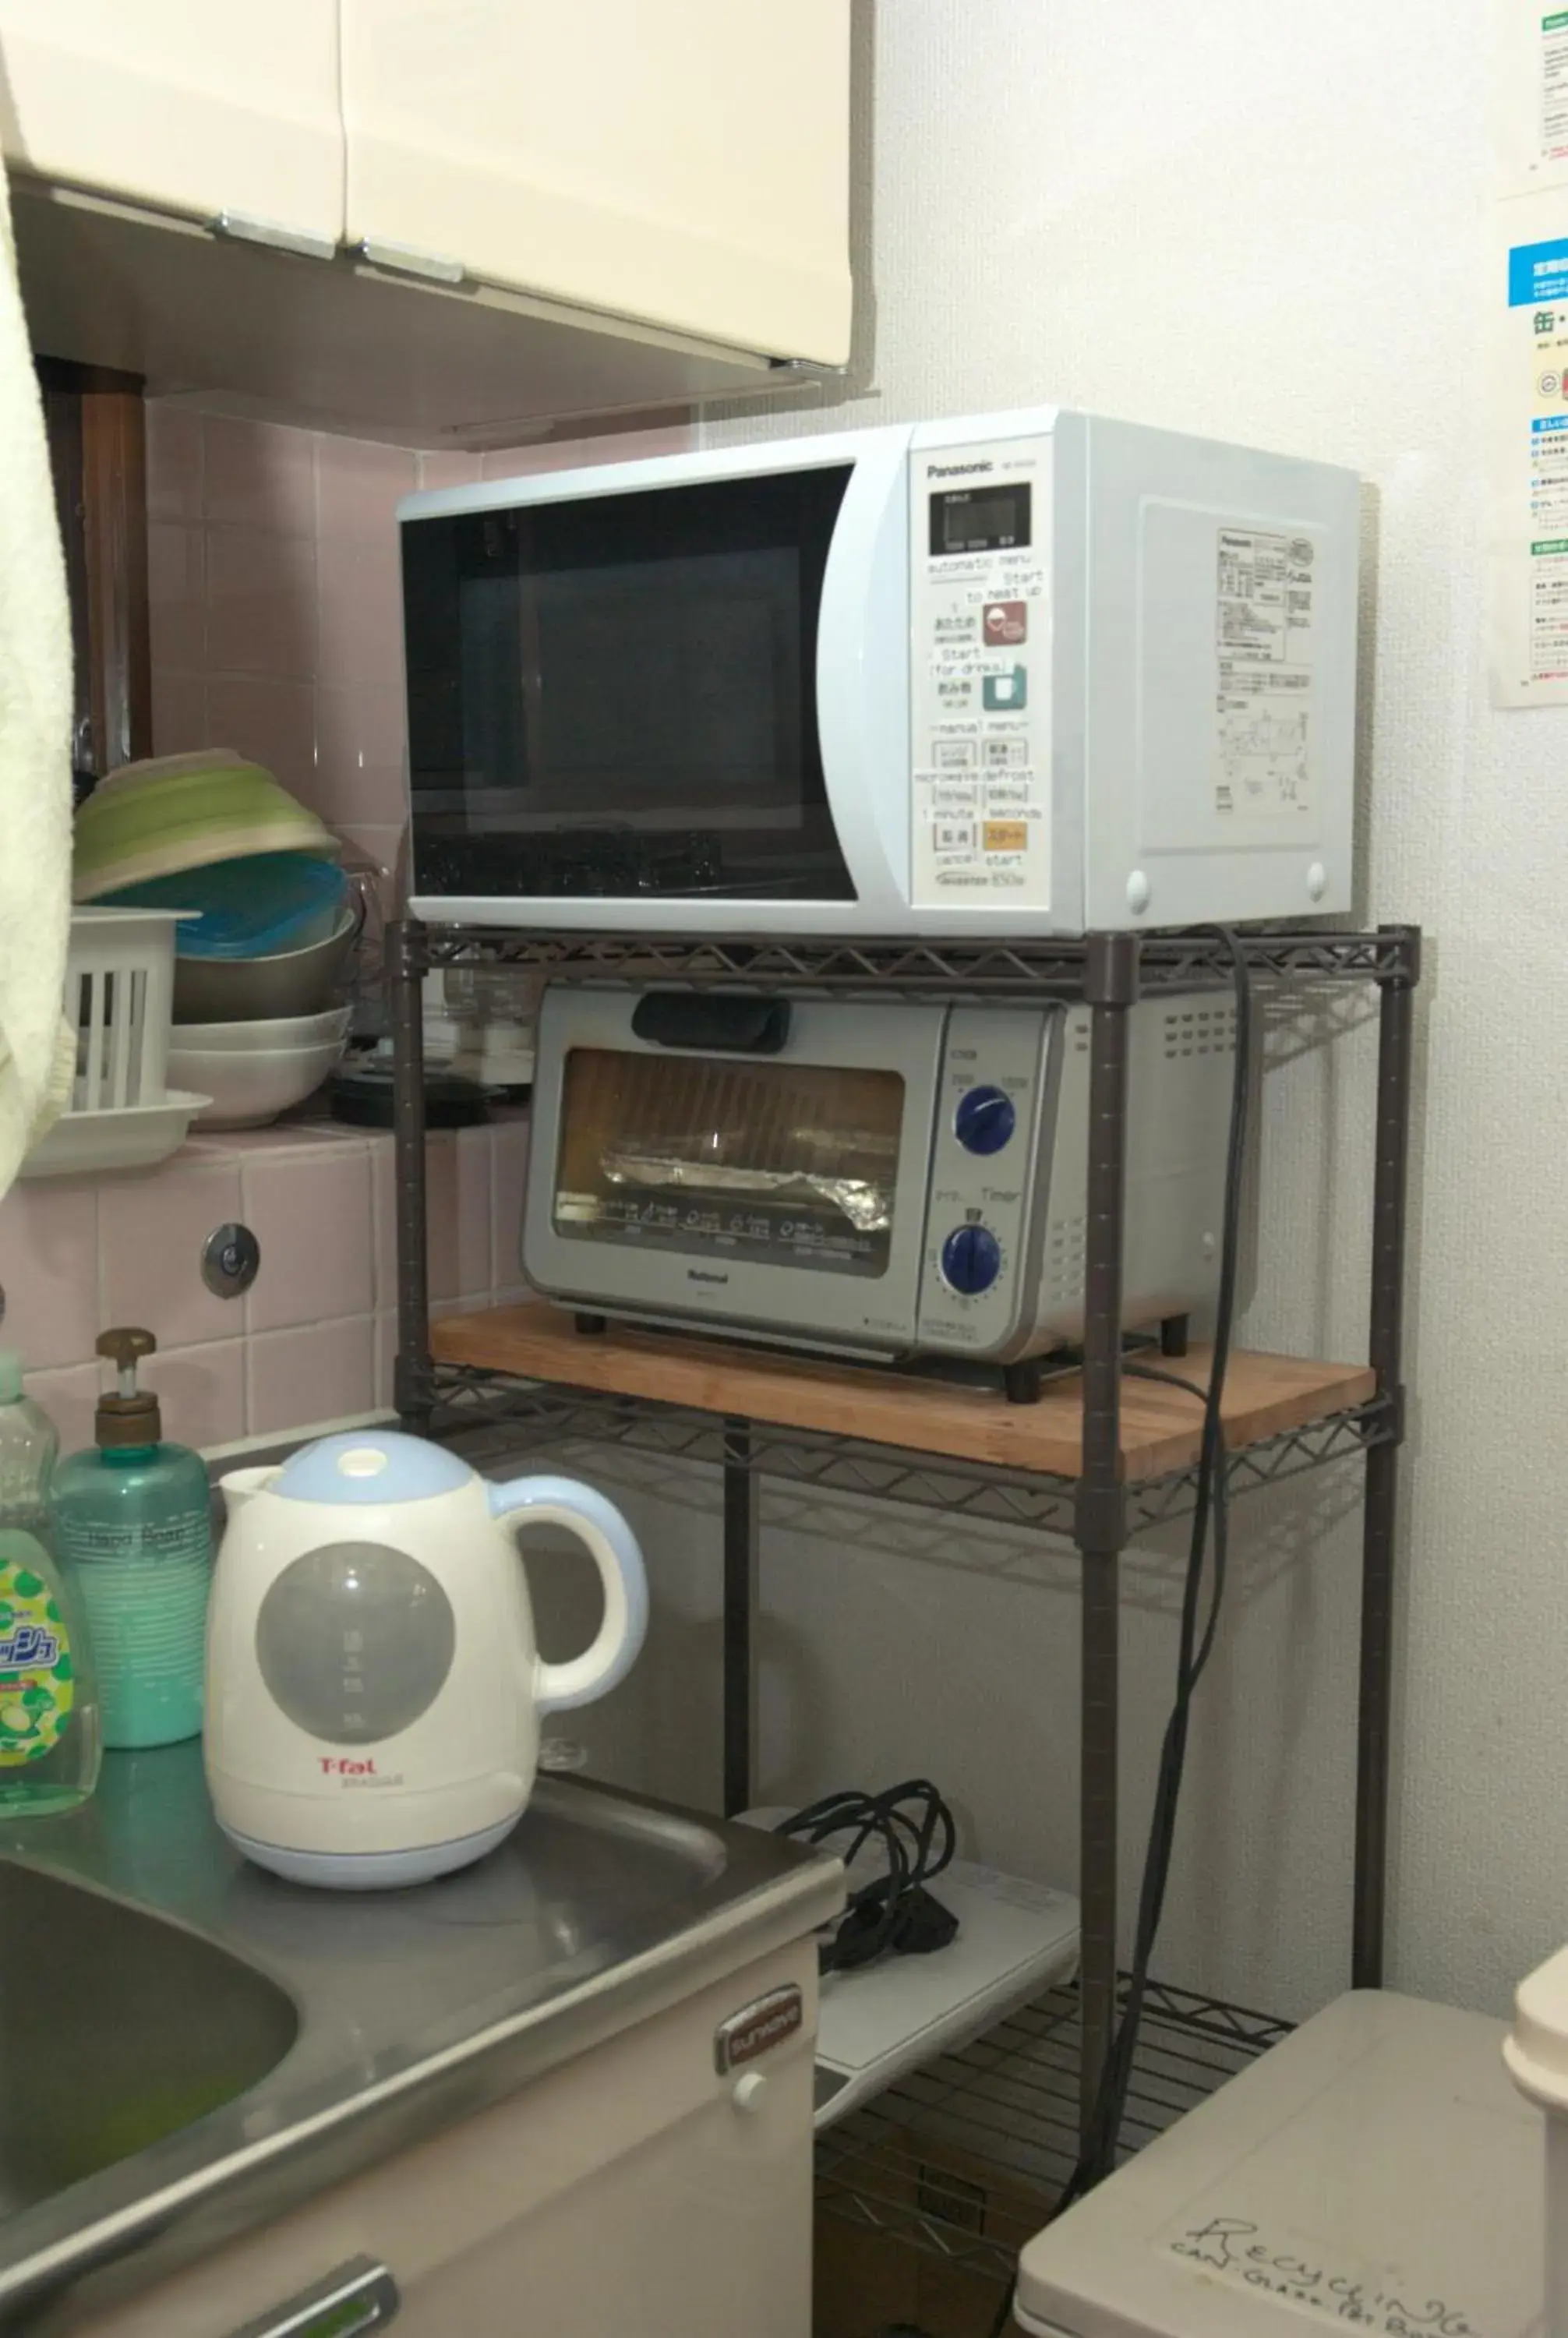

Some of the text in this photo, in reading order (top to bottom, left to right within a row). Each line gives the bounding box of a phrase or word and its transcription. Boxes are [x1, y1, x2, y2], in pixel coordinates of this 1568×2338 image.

[927, 460, 994, 479] Panasonic
[927, 554, 1033, 574] automatic menu
[1003, 569, 1044, 584] Start
[967, 591, 983, 603] to
[987, 587, 1019, 600] heat
[941, 648, 981, 661] Start
[985, 768, 1035, 783] defrost
[319, 1757, 379, 1775] T-fal
